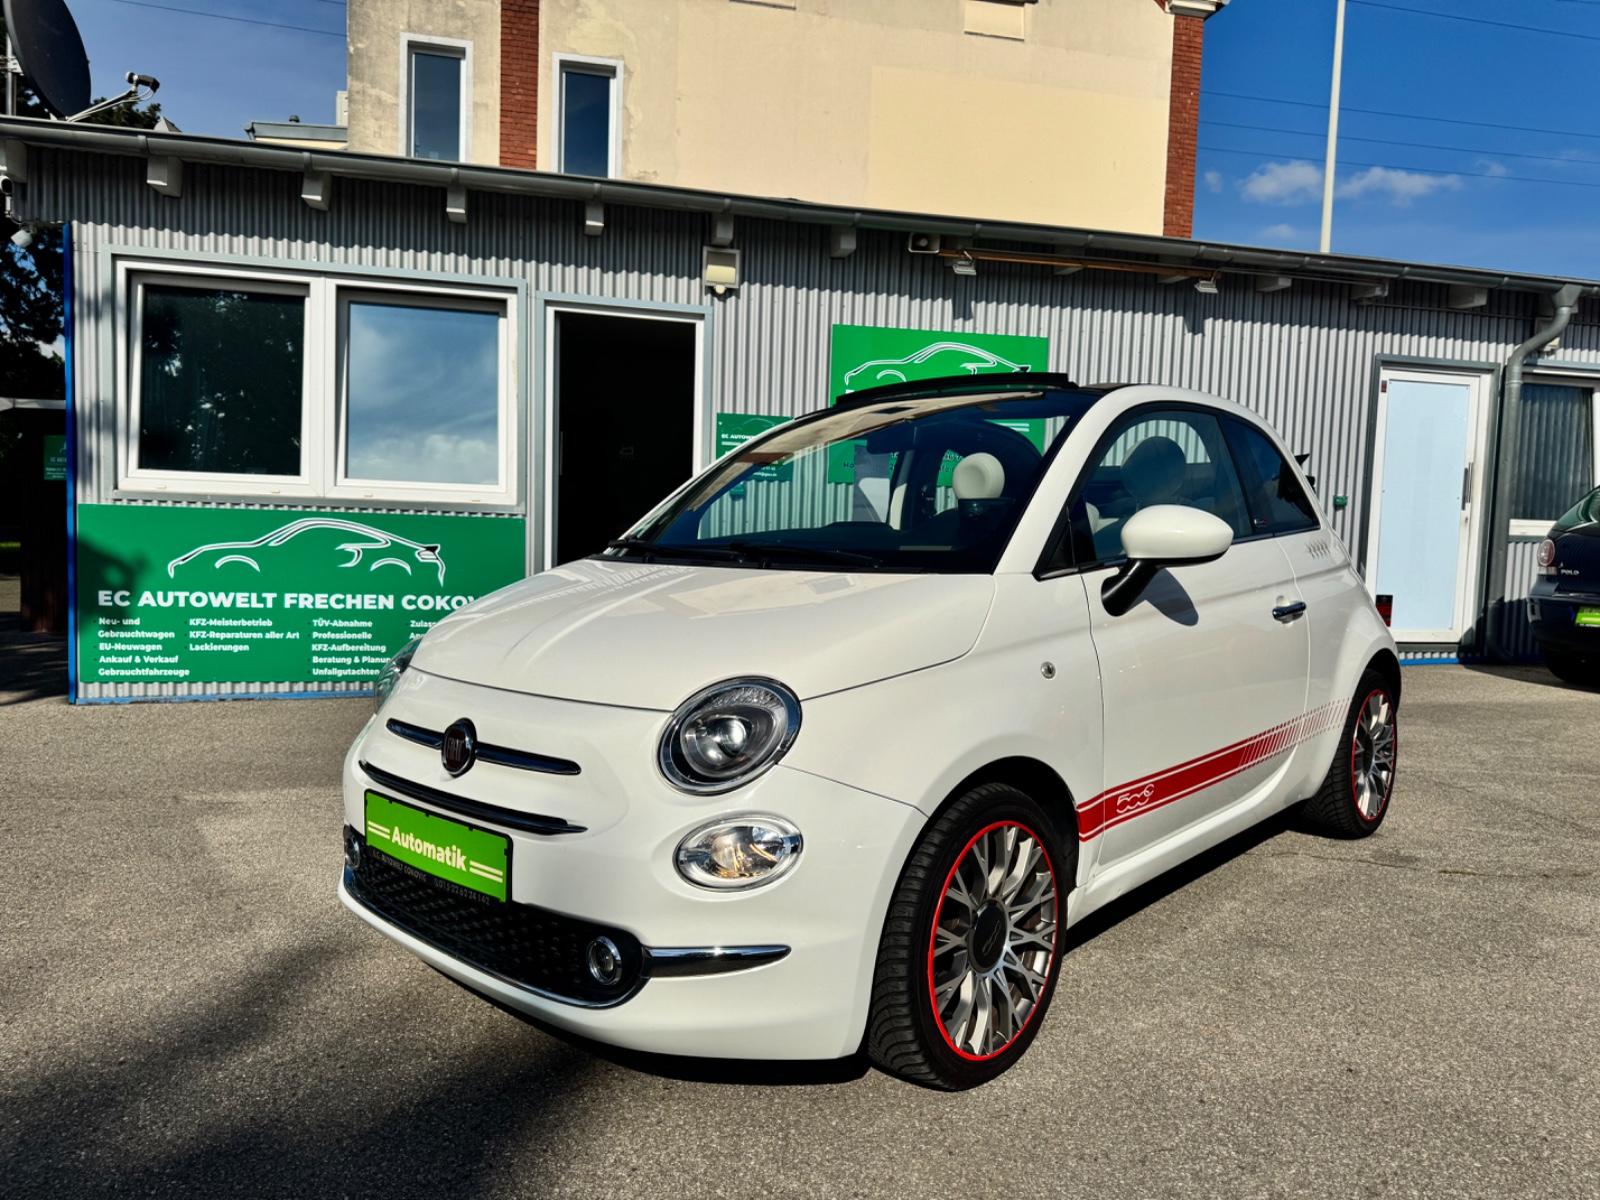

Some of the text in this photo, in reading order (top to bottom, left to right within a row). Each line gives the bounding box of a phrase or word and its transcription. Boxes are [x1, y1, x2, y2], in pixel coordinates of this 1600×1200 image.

[98, 590, 131, 606] EC
[137, 591, 278, 608] AUTOWELT
[284, 592, 394, 609] FRECHEN
[99, 617, 140, 626] Neu- und
[189, 618, 273, 627] KFZ-Meisterbetrieb
[312, 618, 373, 628] TÜV-Abnahme
[98, 630, 175, 640] Gebrauchtwagen
[189, 631, 263, 640] KFZ-Reparaturen
[312, 632, 373, 640] Professionelle
[99, 643, 162, 652] EU-Neuwagen
[189, 643, 250, 653] Lackierungen
[311, 643, 387, 653] KFZ-Aufbereitung
[99, 655, 179, 664] Ankauf & Verkauf
[312, 656, 352, 665] Beratung
[98, 668, 190, 678] Gebrauchtfahrzeuge
[312, 668, 380, 677] Unfallgutachten
[1115, 783, 1155, 814] 500
[391, 826, 467, 872] Automatik
